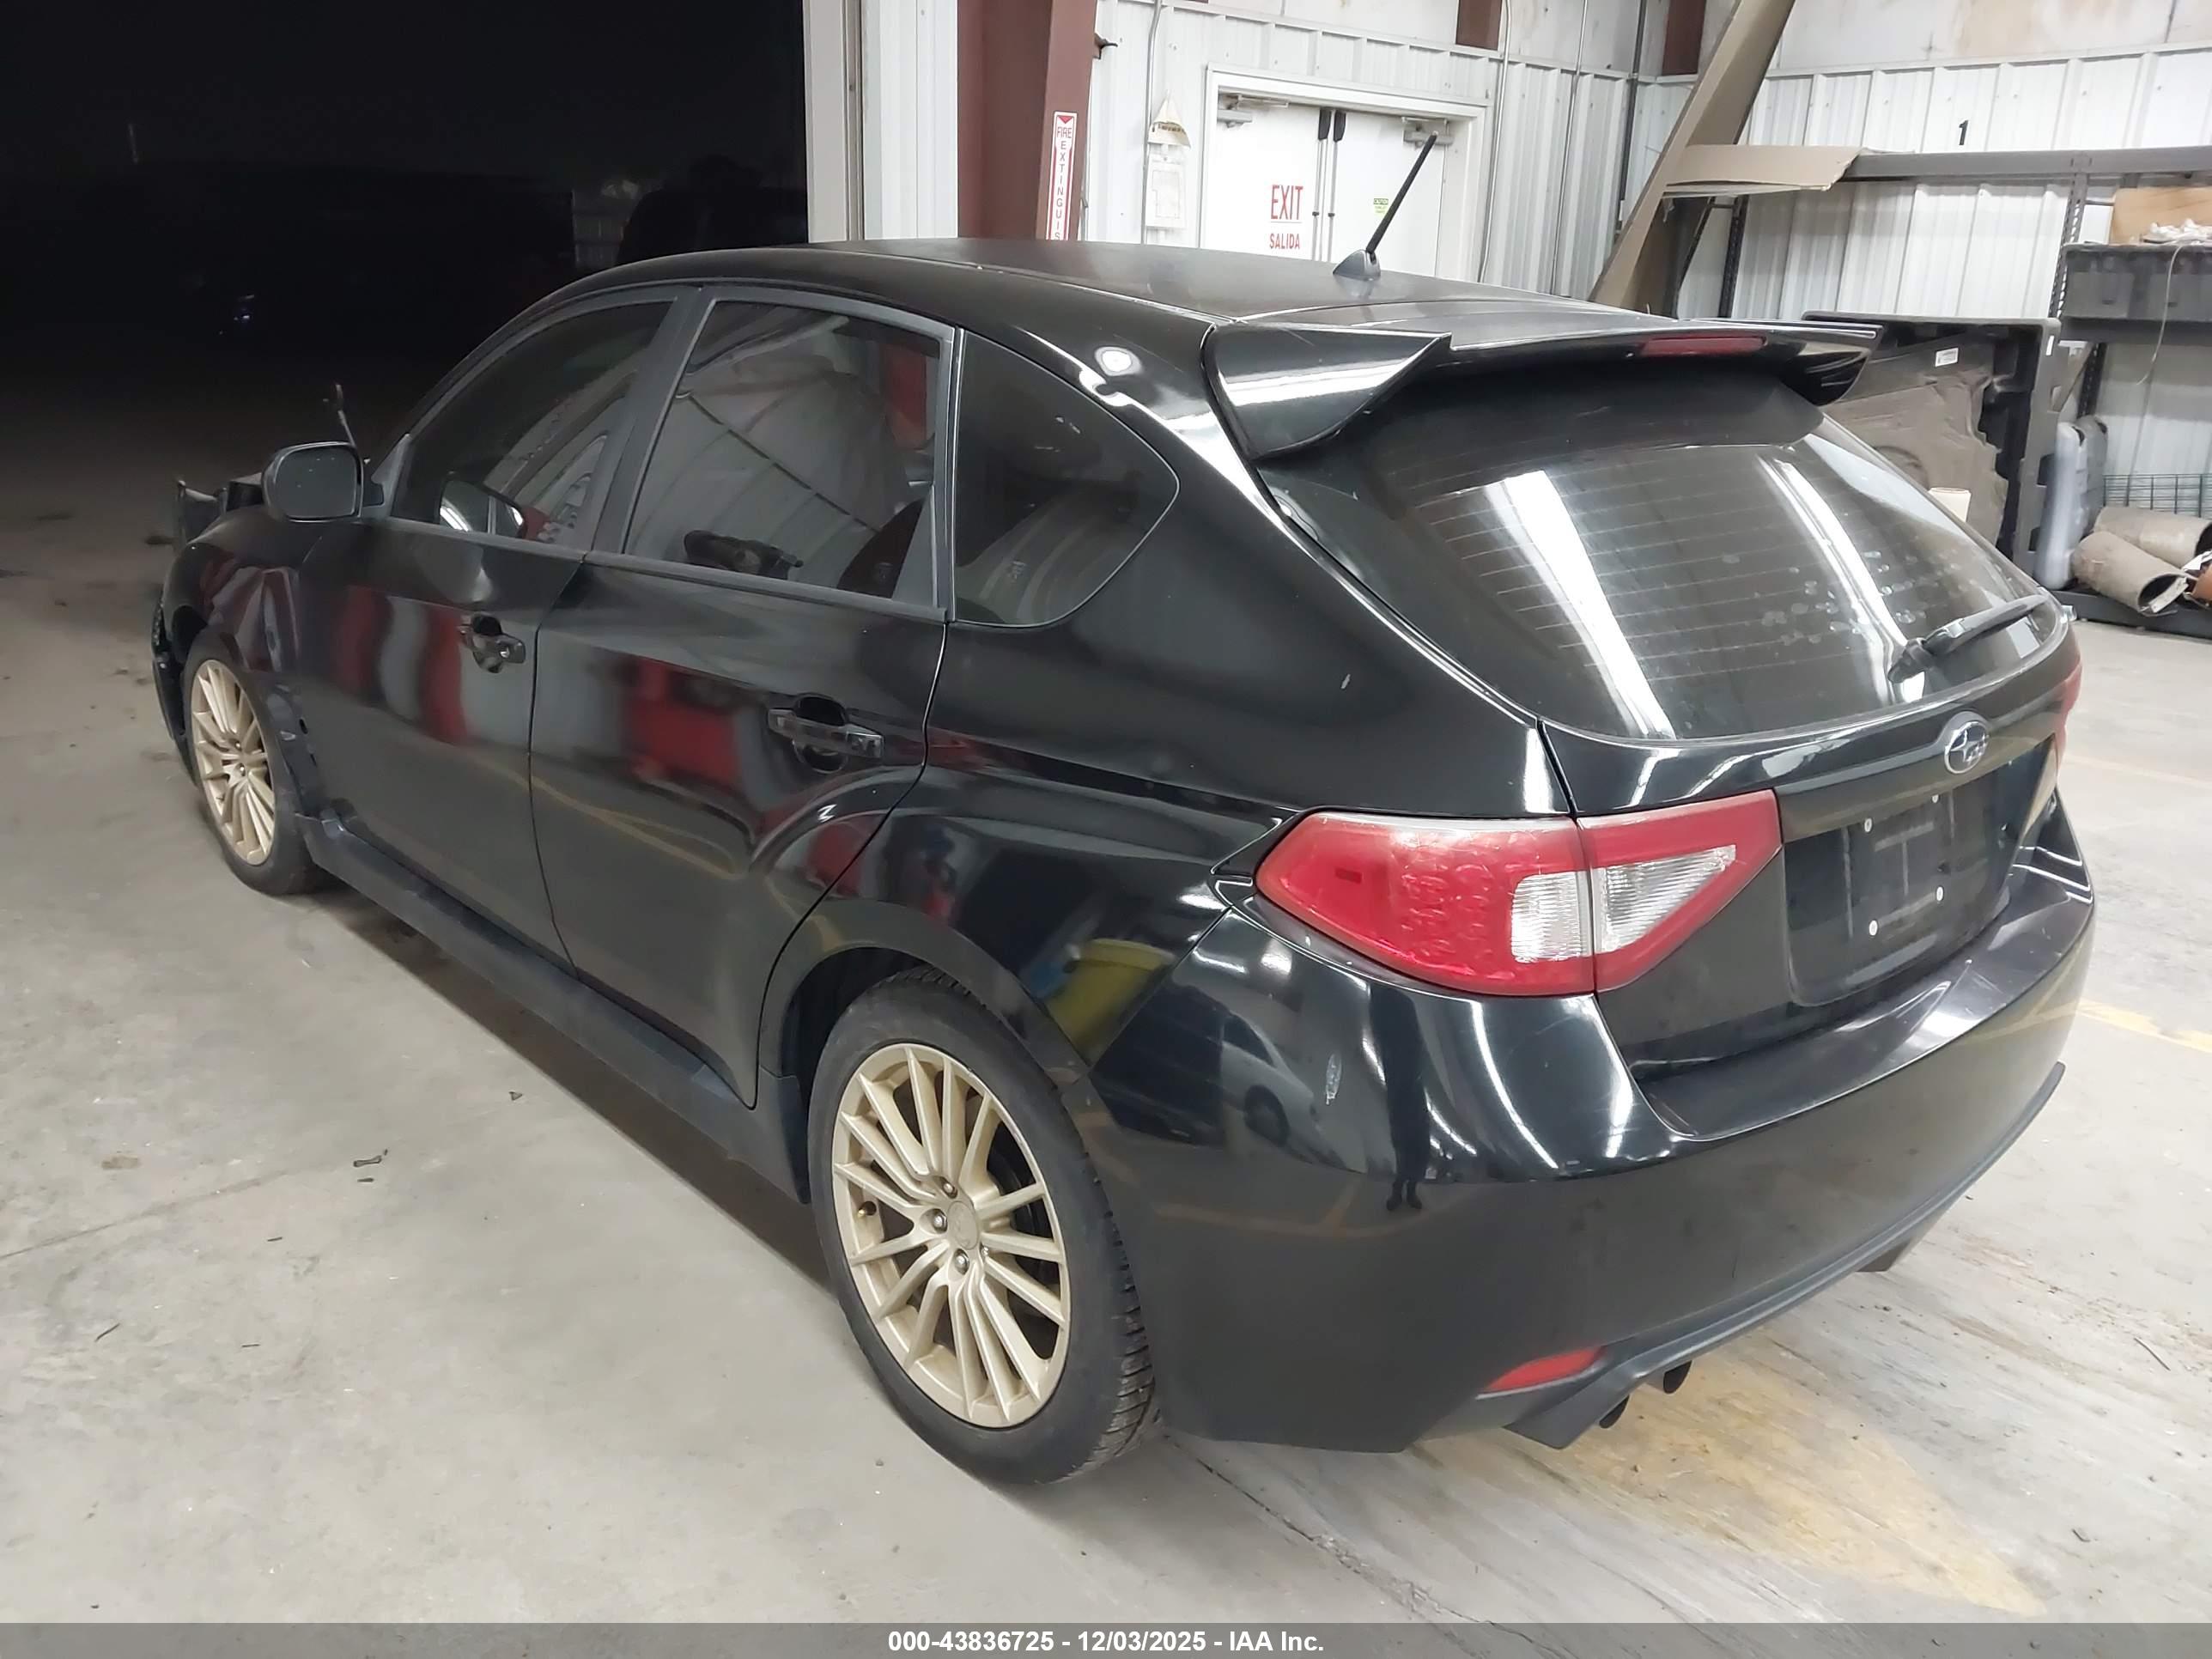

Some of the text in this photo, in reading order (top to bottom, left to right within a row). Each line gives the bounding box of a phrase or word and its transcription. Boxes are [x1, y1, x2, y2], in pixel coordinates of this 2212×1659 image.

[1056, 126, 1073, 138] FIRE
[1958, 119, 1969, 145] 1
[1270, 184, 1304, 221] EXIT
[1268, 233, 1301, 249] SALIDA
